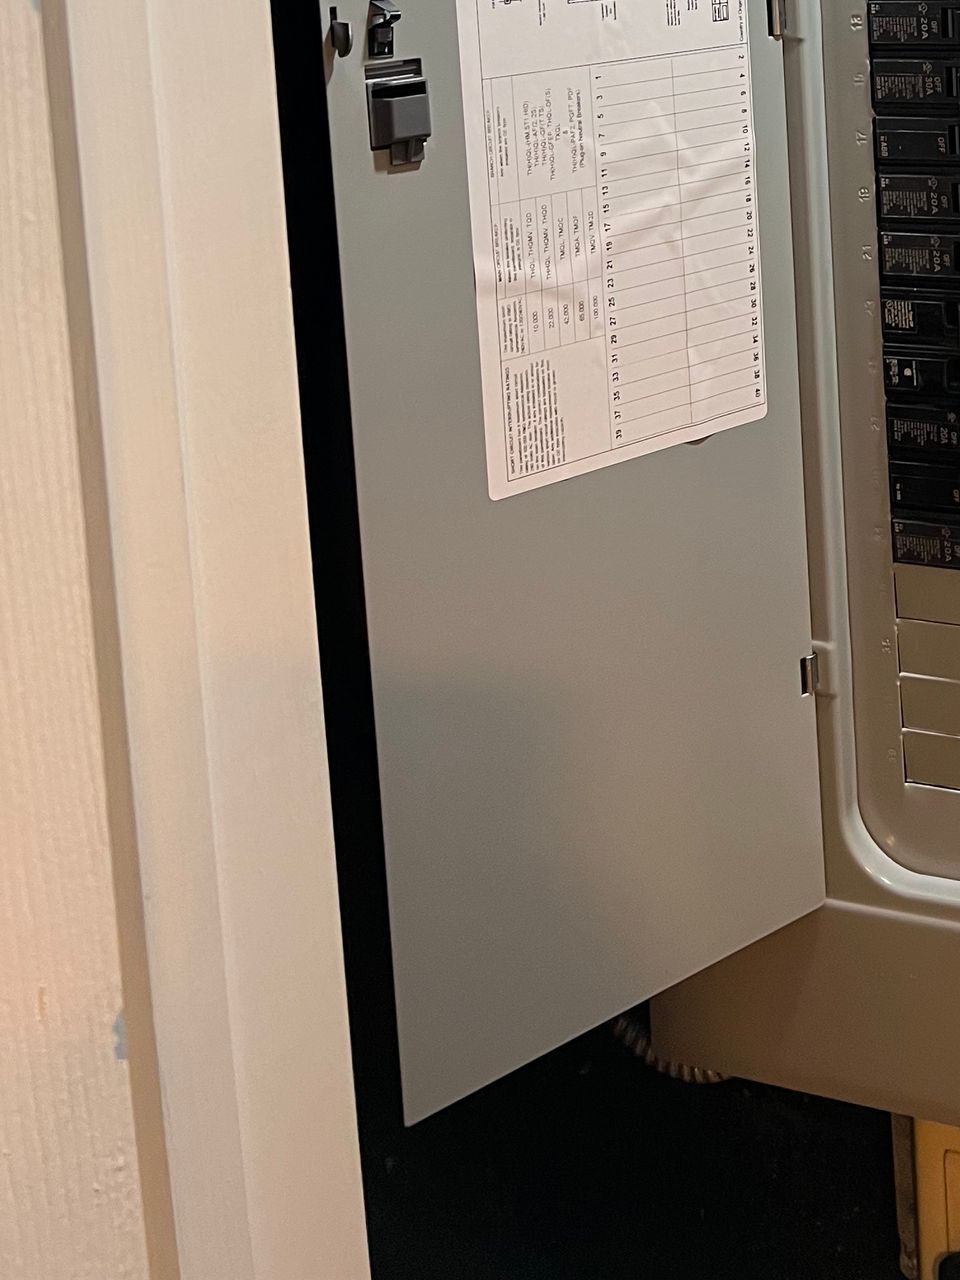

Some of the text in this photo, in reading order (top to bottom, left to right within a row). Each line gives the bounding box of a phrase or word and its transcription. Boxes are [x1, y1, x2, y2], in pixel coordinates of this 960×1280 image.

[925, 77, 933, 95] 30A
[934, 77, 942, 92] OFF
[742, 124, 748, 134] 10
[744, 143, 750, 152] 12
[744, 159, 750, 169] 14
[601, 168, 607, 177] 11
[745, 176, 751, 185] 16
[603, 186, 609, 195] 13
[745, 194, 751, 203] 18
[930, 193, 938, 214] 20A
[604, 204, 610, 213] 15
[746, 211, 753, 220] 20
[604, 223, 611, 232] 17
[747, 229, 753, 237] 22
[606, 241, 612, 251] 19
[748, 246, 754, 255] 24
[607, 260, 613, 269] 21
[749, 264, 755, 273] 26
[607, 278, 614, 288] 23
[750, 281, 756, 291] 28
[608, 297, 615, 307] 25
[751, 298, 757, 308] 30
[610, 317, 617, 326] 27
[751, 317, 758, 326] 32
[611, 335, 617, 344] 29
[612, 353, 618, 363] 31
[753, 352, 759, 362] 36
[613, 372, 619, 381] 33
[754, 369, 760, 379] 38
[613, 391, 620, 401] 35
[755, 388, 761, 397] 40
[615, 410, 621, 419] 37
[616, 429, 622, 439] 39
[940, 427, 948, 444] 20A
[944, 540, 952, 562] 20A
